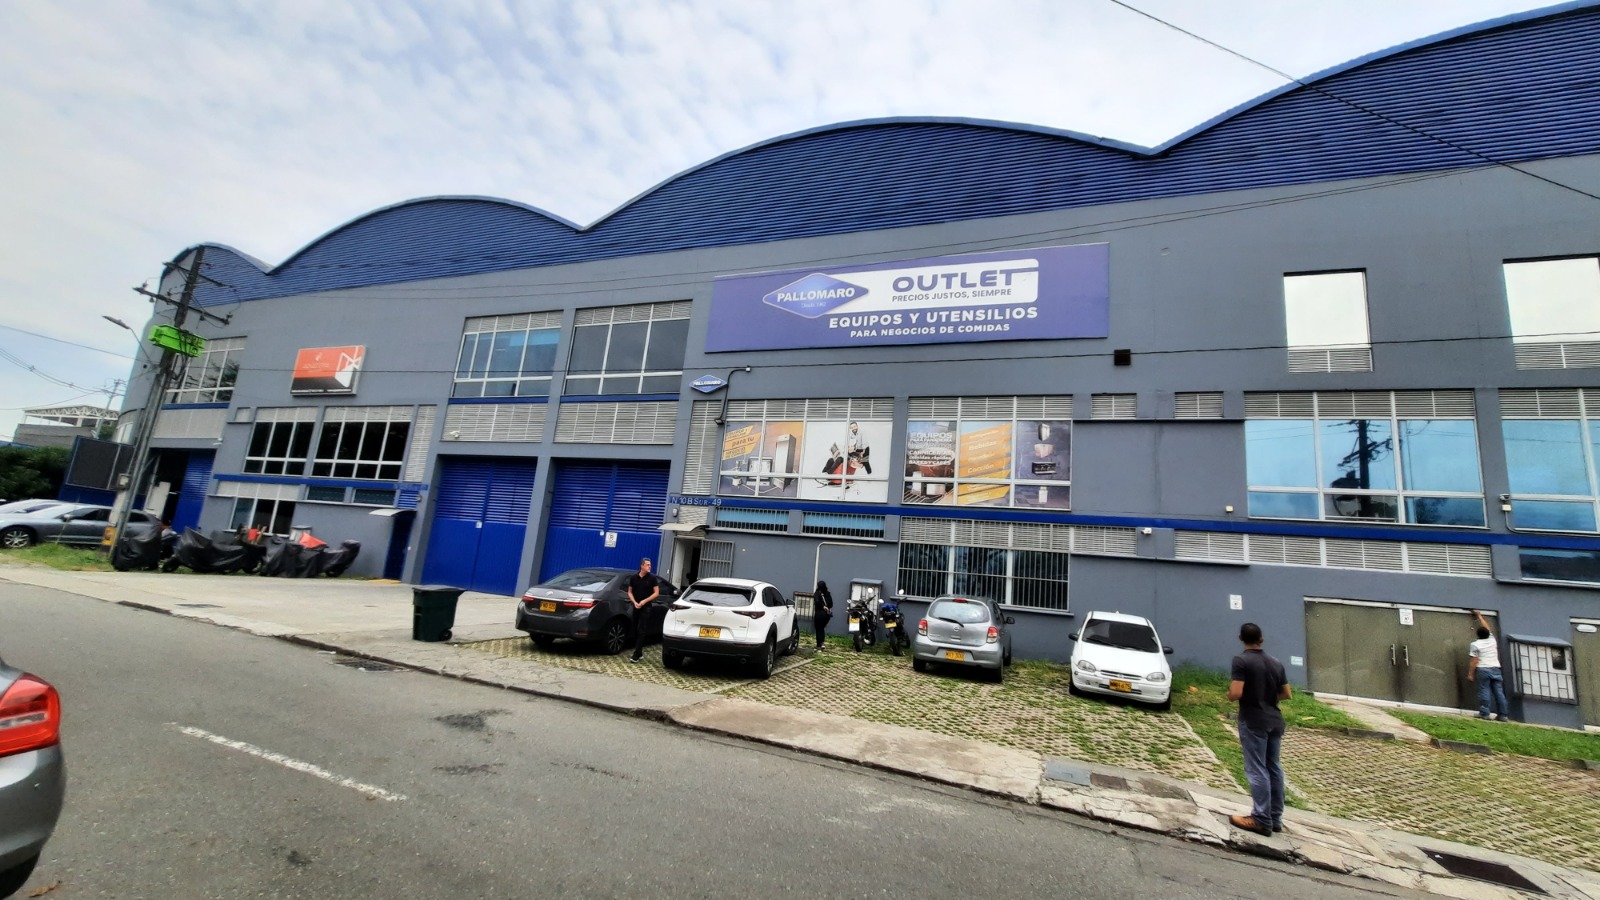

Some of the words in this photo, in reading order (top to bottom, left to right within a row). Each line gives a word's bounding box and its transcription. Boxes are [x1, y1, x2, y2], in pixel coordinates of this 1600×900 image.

[892, 269, 1015, 293] OUTLET
[777, 287, 855, 302] PALLOMARO
[892, 293, 930, 302] PRECIOS
[932, 290, 970, 300] JUSTOS,
[972, 288, 1012, 298] SIEMPRE
[829, 313, 902, 328] EQUIPOS
[909, 312, 920, 324] Y
[926, 306, 1038, 323] UTENSILIOS
[850, 330, 877, 338] PARA
[881, 326, 936, 336] NEGOCIOS
[939, 326, 954, 334] DE
[958, 323, 1010, 333] COMIDAS
[732, 438, 747, 447] para
[968, 463, 994, 474] Cocción
[671, 496, 678, 504] N
